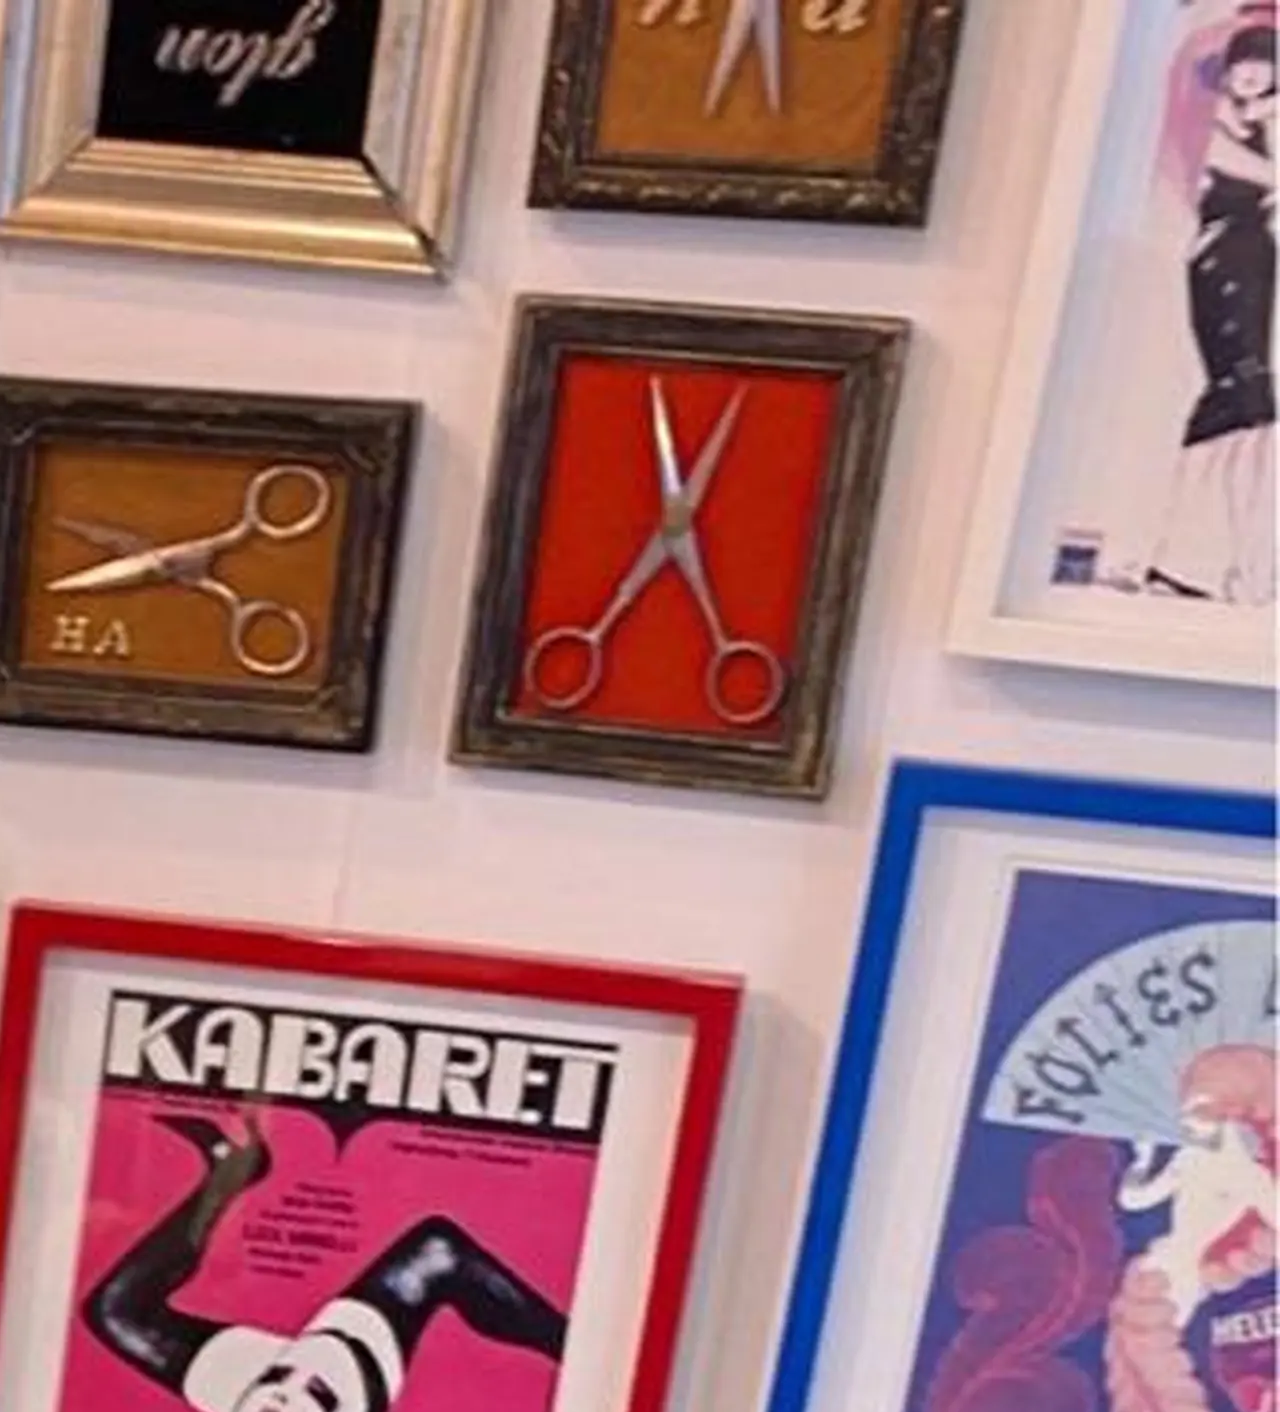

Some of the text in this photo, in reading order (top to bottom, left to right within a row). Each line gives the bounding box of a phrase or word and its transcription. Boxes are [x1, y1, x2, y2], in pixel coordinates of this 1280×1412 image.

[50, 615, 130, 655] HA
[105, 998, 618, 1131] KABARET
[1014, 950, 1218, 1125] FOLIES
